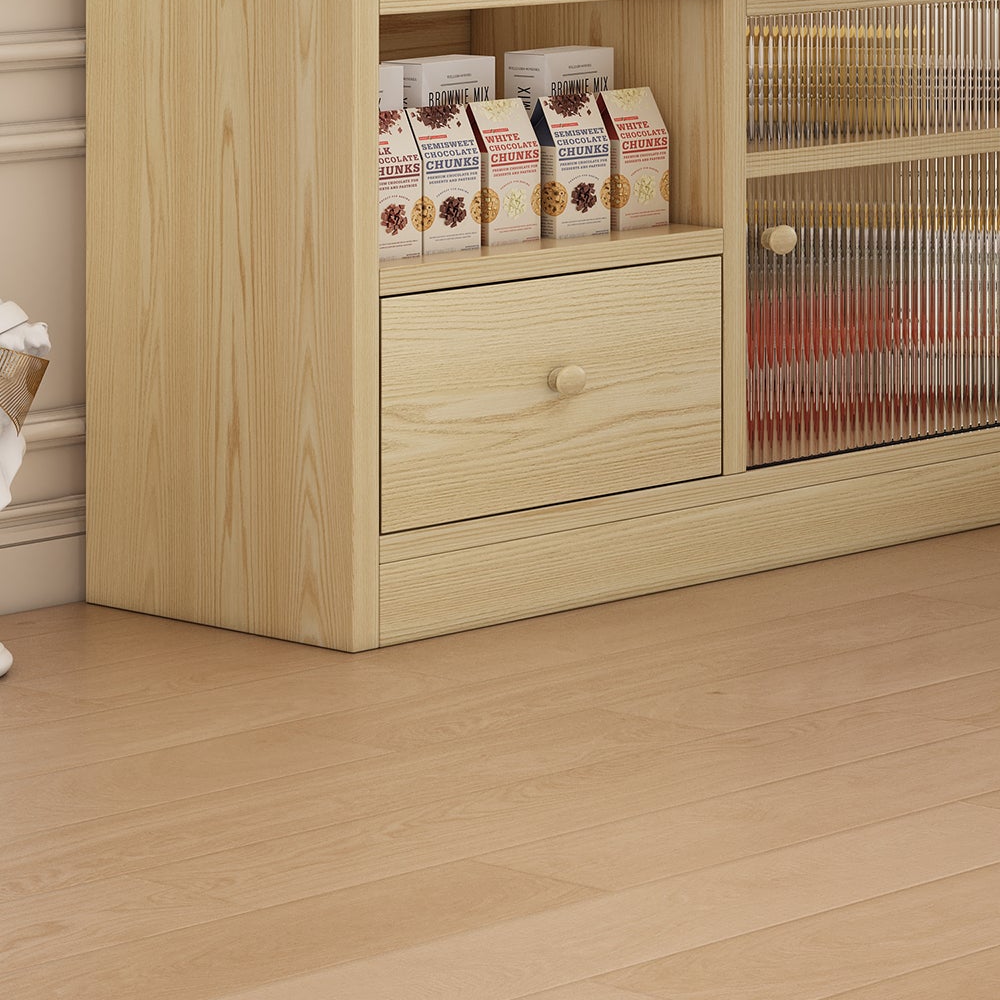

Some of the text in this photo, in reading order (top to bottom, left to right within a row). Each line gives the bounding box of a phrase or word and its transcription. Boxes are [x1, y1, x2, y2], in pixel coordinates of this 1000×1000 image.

[551, 76, 609, 97] BROWNIE MIX
[428, 86, 490, 107] BROWNIE MIX
[616, 120, 650, 131] WHITE
[485, 132, 520, 144] WHITE
[554, 127, 604, 138] SEMISWEET
[620, 128, 667, 139] CHOCOLATE
[421, 139, 475, 151] SEMISWEET
[489, 140, 539, 152] CHOCOLATE
[557, 135, 608, 146] CHOCOLATE
[622, 136, 668, 150] CHUNKS
[379, 147, 392, 156] LK
[424, 147, 479, 159] CHOCOLATE
[491, 149, 540, 163] CHUNKS
[558, 143, 609, 157] CHUNKS
[379, 154, 420, 164] OCOLATE
[426, 156, 480, 170] CHUNKS
[379, 163, 421, 177] HUNKS
